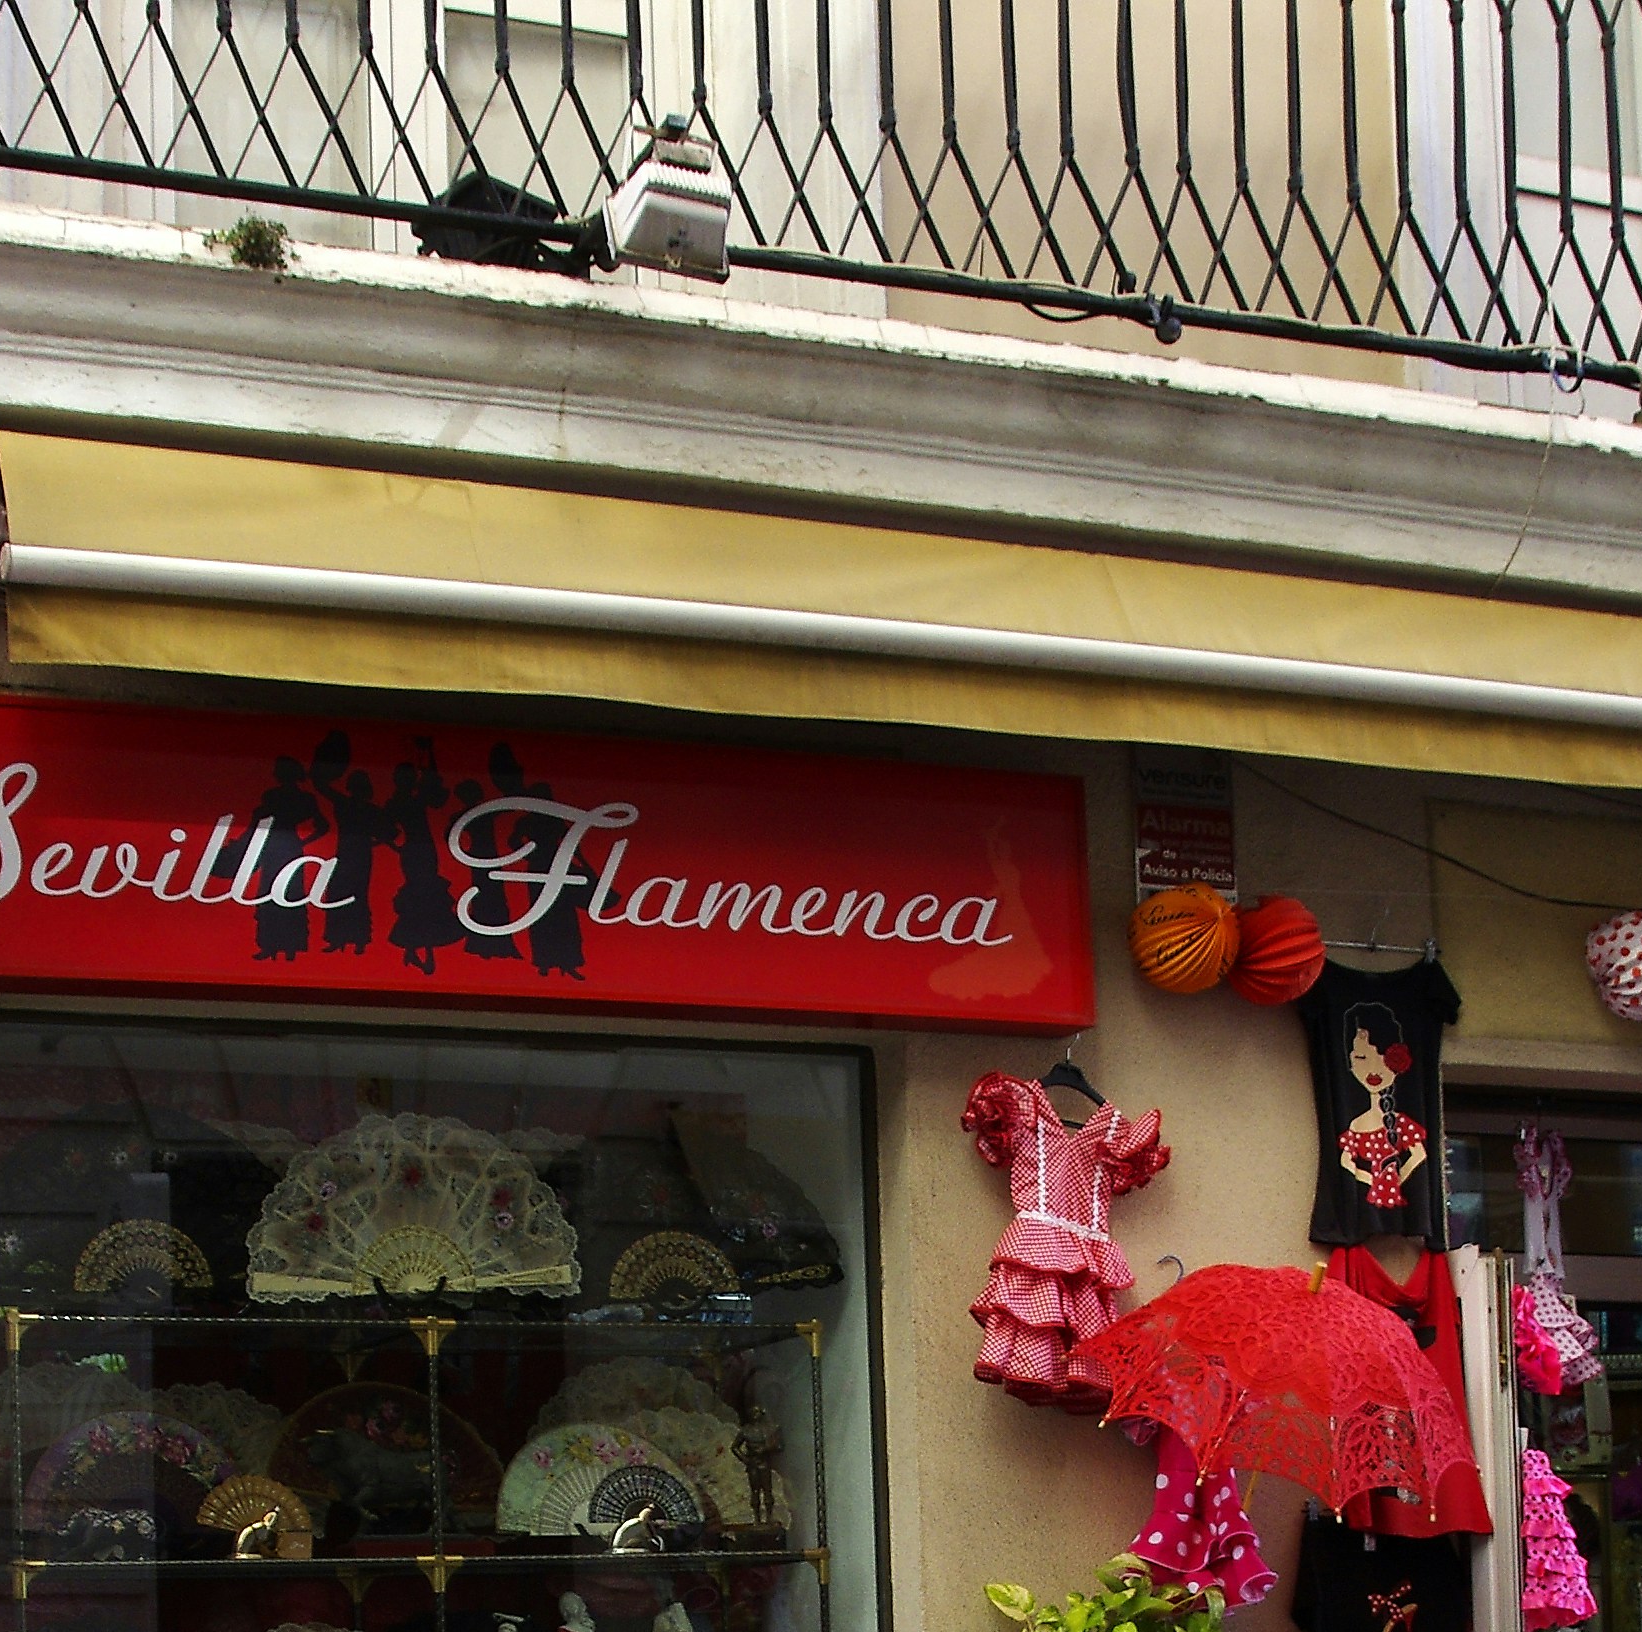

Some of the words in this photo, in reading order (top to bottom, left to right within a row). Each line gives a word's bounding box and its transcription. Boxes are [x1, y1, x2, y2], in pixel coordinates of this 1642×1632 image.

[1141, 809, 1230, 836] Alarma
[448, 795, 1014, 947] Flamenca
[1143, 863, 1178, 878] Aviso
[1181, 868, 1190, 879] a
